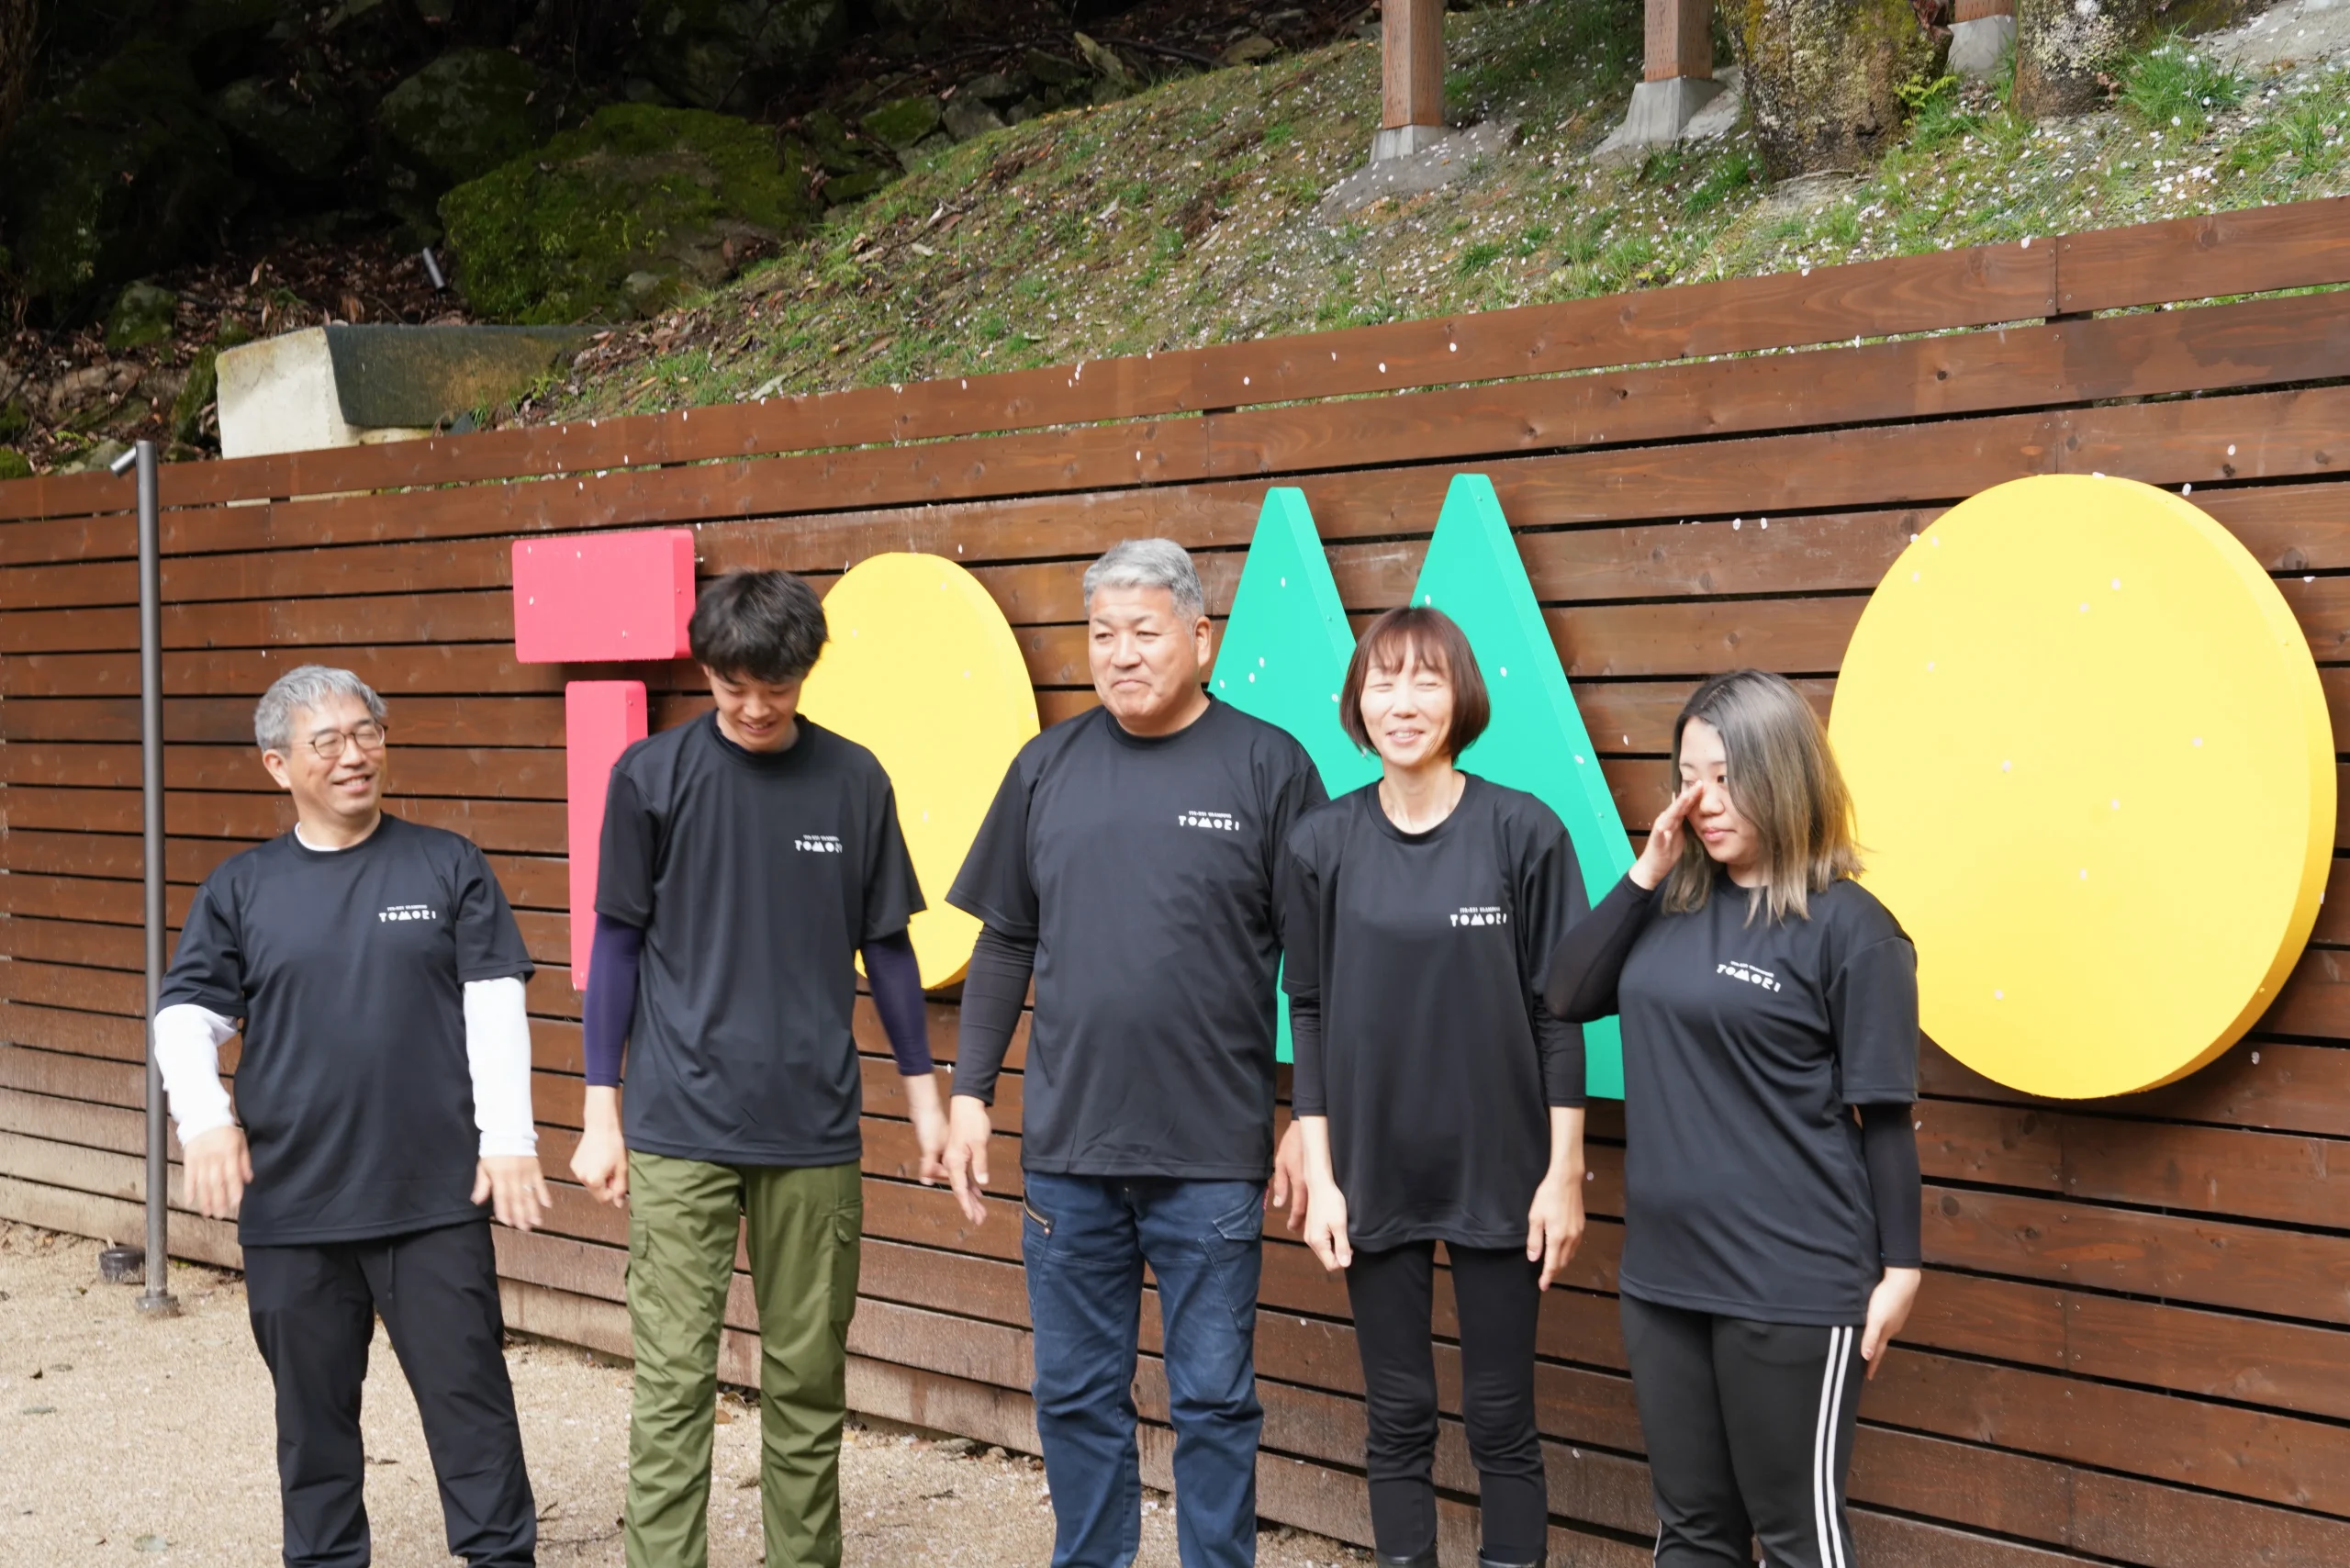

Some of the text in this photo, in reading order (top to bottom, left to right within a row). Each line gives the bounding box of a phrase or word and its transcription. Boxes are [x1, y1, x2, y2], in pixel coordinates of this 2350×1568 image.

[1178, 815, 1240, 831] TOMORI
[378, 910, 437, 923] TOMORI
[1449, 913, 1507, 927] TOMORI
[1716, 963, 1782, 993] TOMORI
